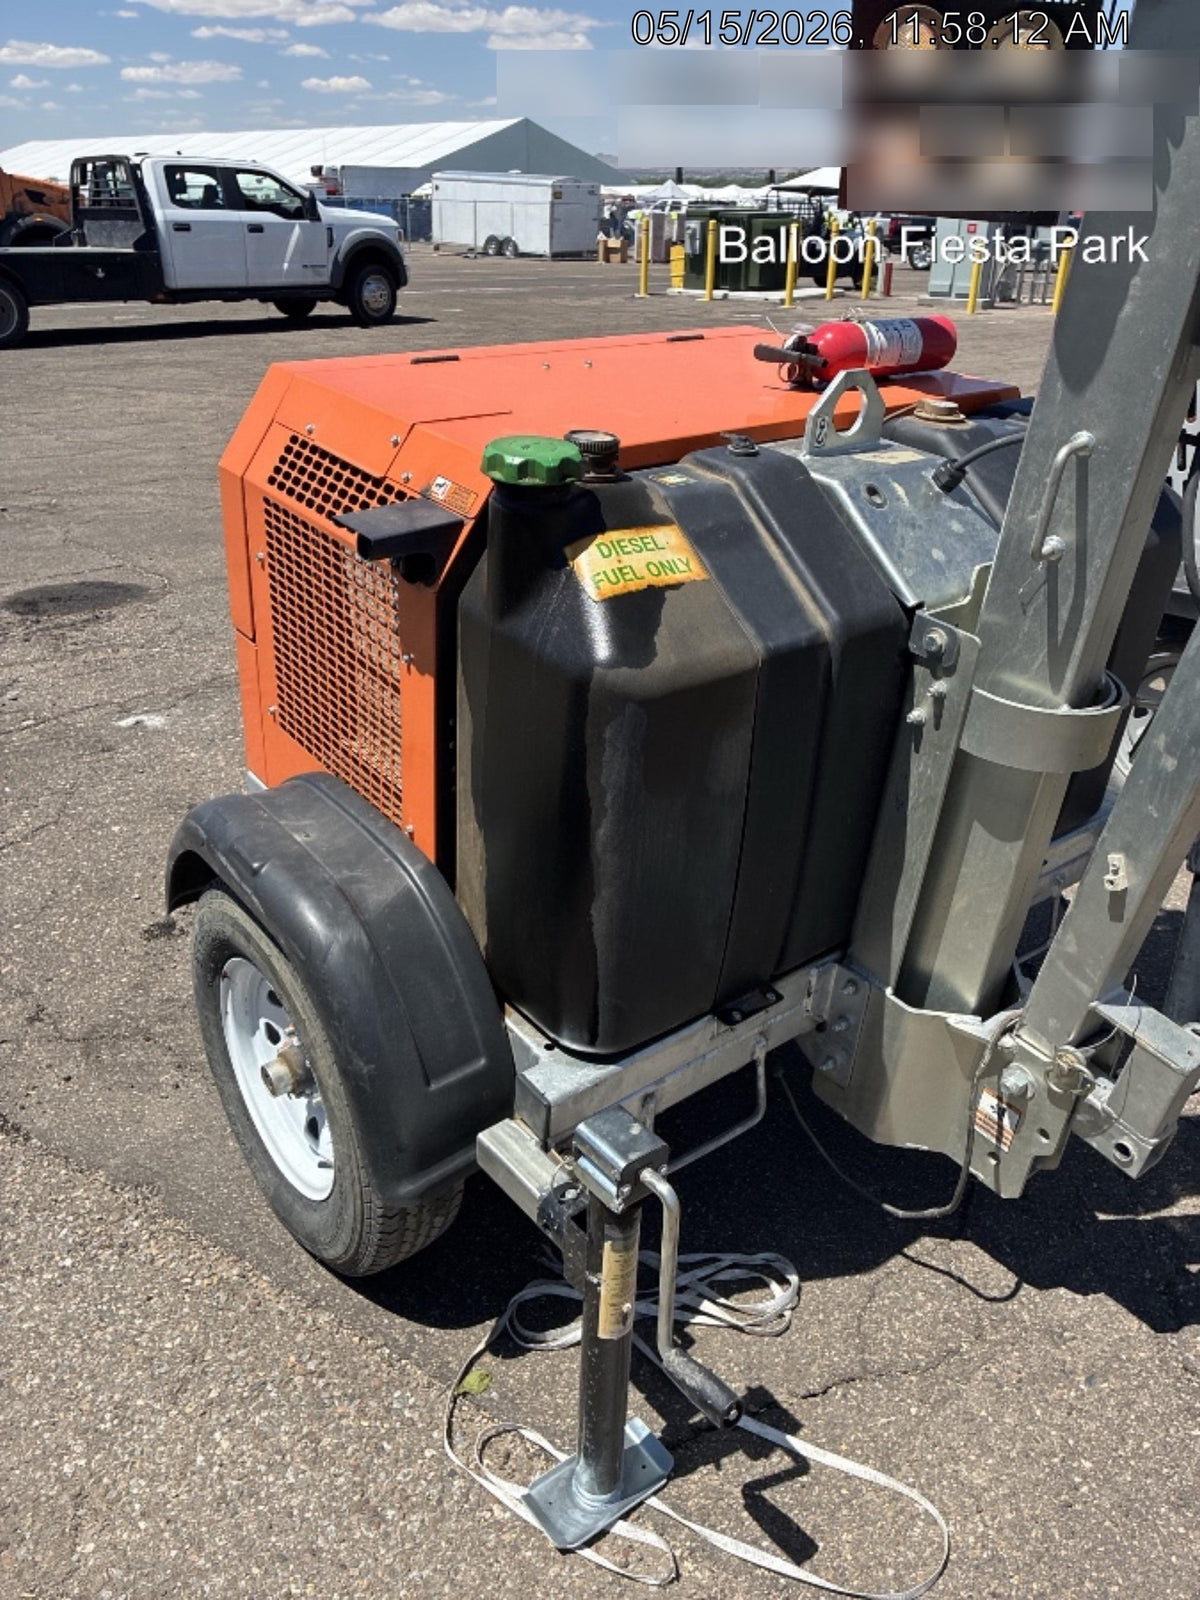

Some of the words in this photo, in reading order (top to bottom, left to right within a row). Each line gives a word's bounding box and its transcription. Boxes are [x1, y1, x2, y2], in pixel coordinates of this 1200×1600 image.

[595, 535, 666, 559] DIESEL
[591, 565, 645, 590] FUEL
[646, 557, 693, 577] ONLY
